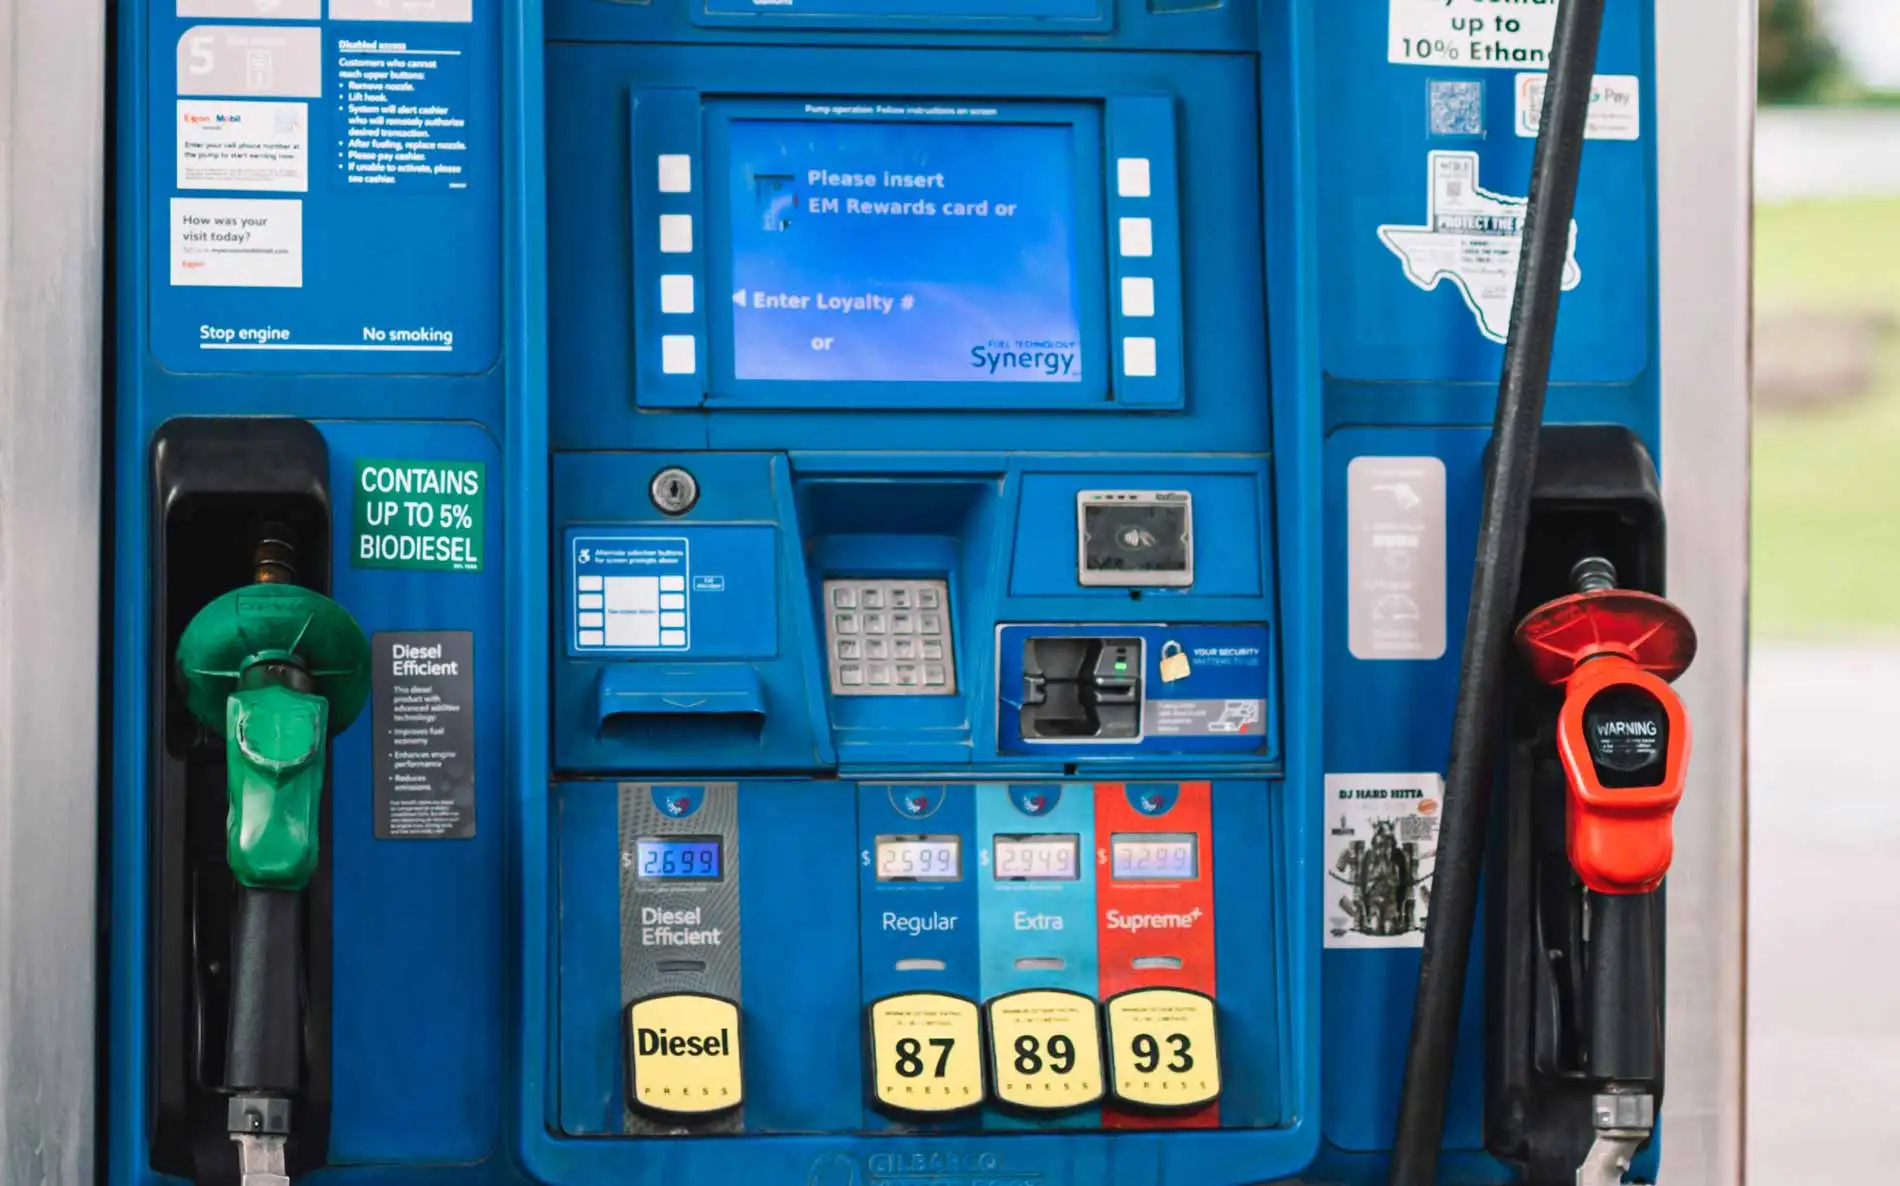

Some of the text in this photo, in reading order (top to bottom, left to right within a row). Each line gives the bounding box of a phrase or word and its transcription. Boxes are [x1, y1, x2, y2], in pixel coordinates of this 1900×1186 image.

[1451, 15, 1520, 36] up to
[188, 37, 215, 75] 5
[1403, 38, 1553, 62] 10% Ethan
[338, 57, 437, 68] Customers who cannot
[363, 71, 388, 80] upper
[348, 92, 363, 101] Lift
[348, 104, 448, 115] System will alert cashier
[348, 116, 367, 125] who
[369, 116, 384, 125] will
[348, 128, 380, 137] desired
[348, 140, 370, 149] After
[404, 141, 436, 152] replace
[348, 150, 376, 160] Please
[377, 152, 393, 162] pay
[356, 163, 385, 172] unable
[386, 164, 396, 172] to
[433, 164, 462, 174] please
[348, 175, 363, 184] see
[808, 169, 945, 188] Please insert
[809, 197, 1017, 216] EM Rewards card or
[182, 214, 268, 230] How was your
[183, 231, 252, 246] visit today?
[753, 291, 915, 314] Enter Loyalty #
[200, 325, 290, 344] Stop engine
[363, 327, 453, 345] No smoking
[811, 336, 834, 350] or
[971, 345, 1074, 375] Synergy
[361, 466, 479, 495] CONTAINS
[367, 501, 472, 529] UP TO 5%
[360, 534, 477, 562] BIODIESEL
[392, 643, 442, 660] Diesel
[1193, 648, 1259, 656] YOUR SECURITY
[392, 659, 459, 676] Efficient
[1597, 721, 1657, 736] WARNING
[1339, 789, 1423, 799] DJ HARD HITTA
[861, 850, 871, 867] $
[980, 849, 989, 866] $
[1097, 848, 1108, 865] $
[641, 907, 701, 925] Diesel
[883, 912, 957, 936] Regular
[1014, 911, 1063, 930] Extra
[641, 926, 722, 946] Efficient
[638, 1028, 729, 1056] Diesel
[895, 1037, 955, 1078] 87
[1014, 1034, 1076, 1075] 89
[1131, 1033, 1194, 1073] 93
[868, 1152, 998, 1174] GILBARCO
